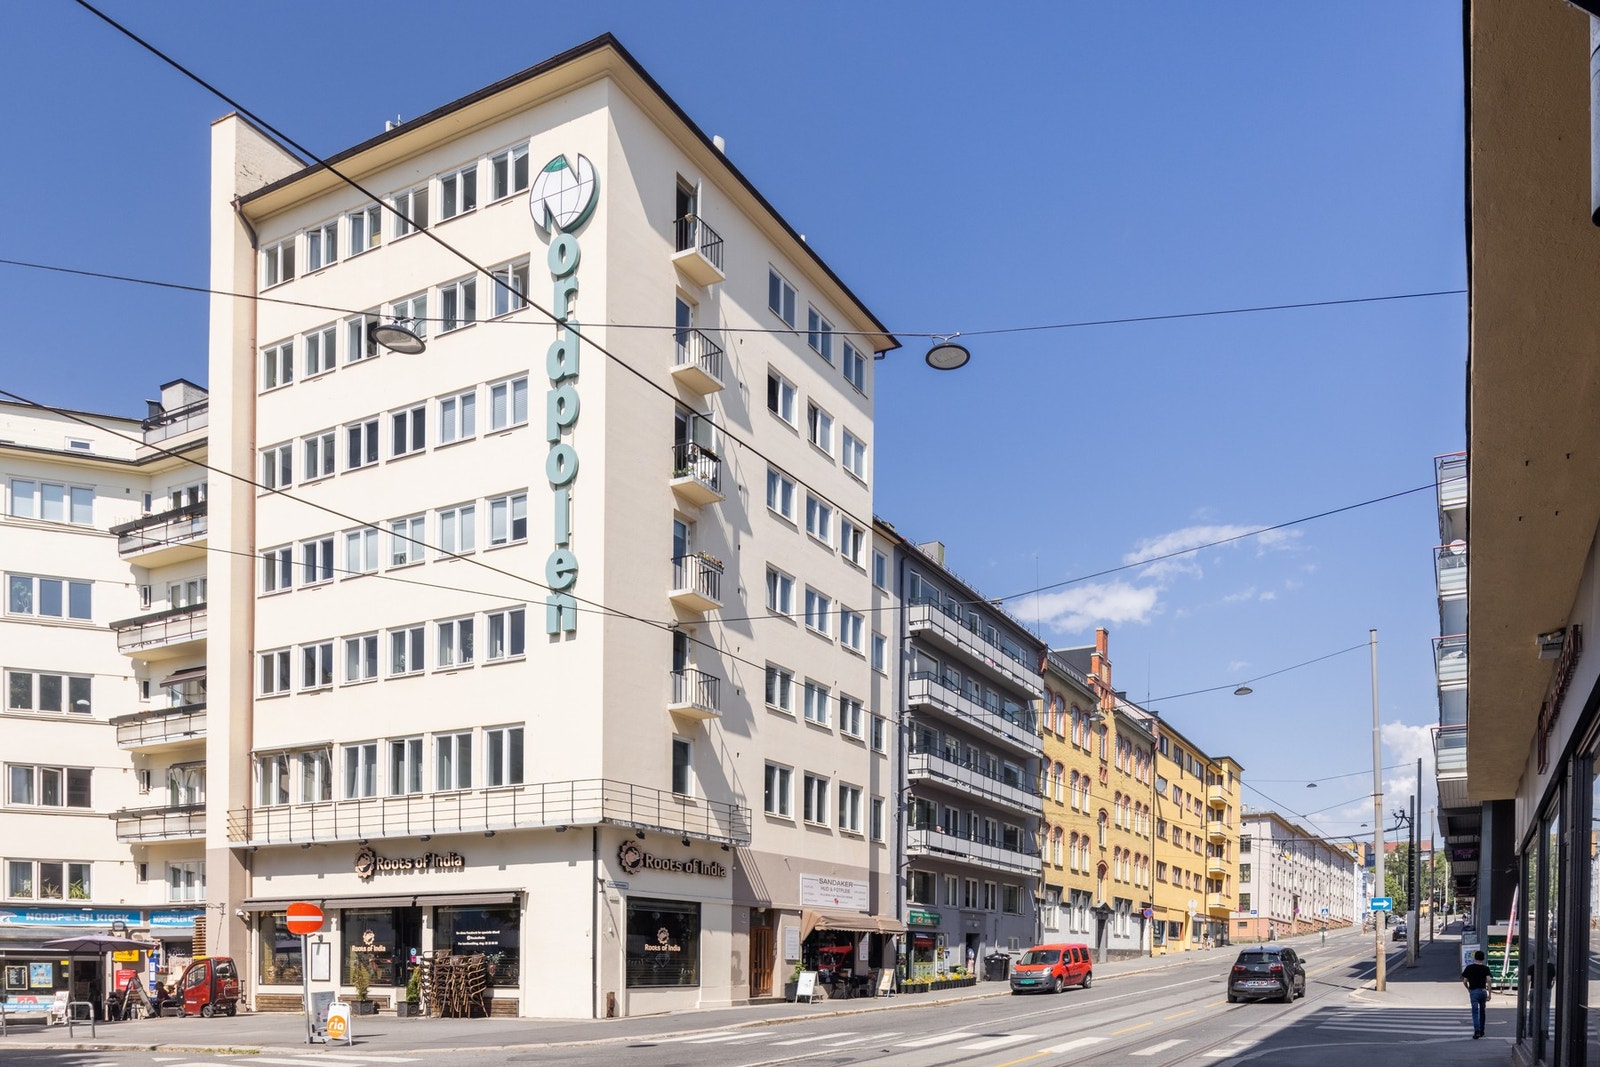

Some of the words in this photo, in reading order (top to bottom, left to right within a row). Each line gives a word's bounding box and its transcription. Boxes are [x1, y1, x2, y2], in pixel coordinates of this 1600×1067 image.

[376, 856, 412, 871] Roots
[415, 852, 431, 869] of
[432, 851, 463, 868] India
[645, 853, 682, 872] Roots
[685, 858, 698, 873] of
[700, 860, 728, 877] India
[818, 877, 854, 888] SANDAKER
[96, 913, 130, 922] KIOSK
[644, 943, 661, 951] Roots
[668, 944, 681, 952] India
[328, 1018, 345, 1031] ria
